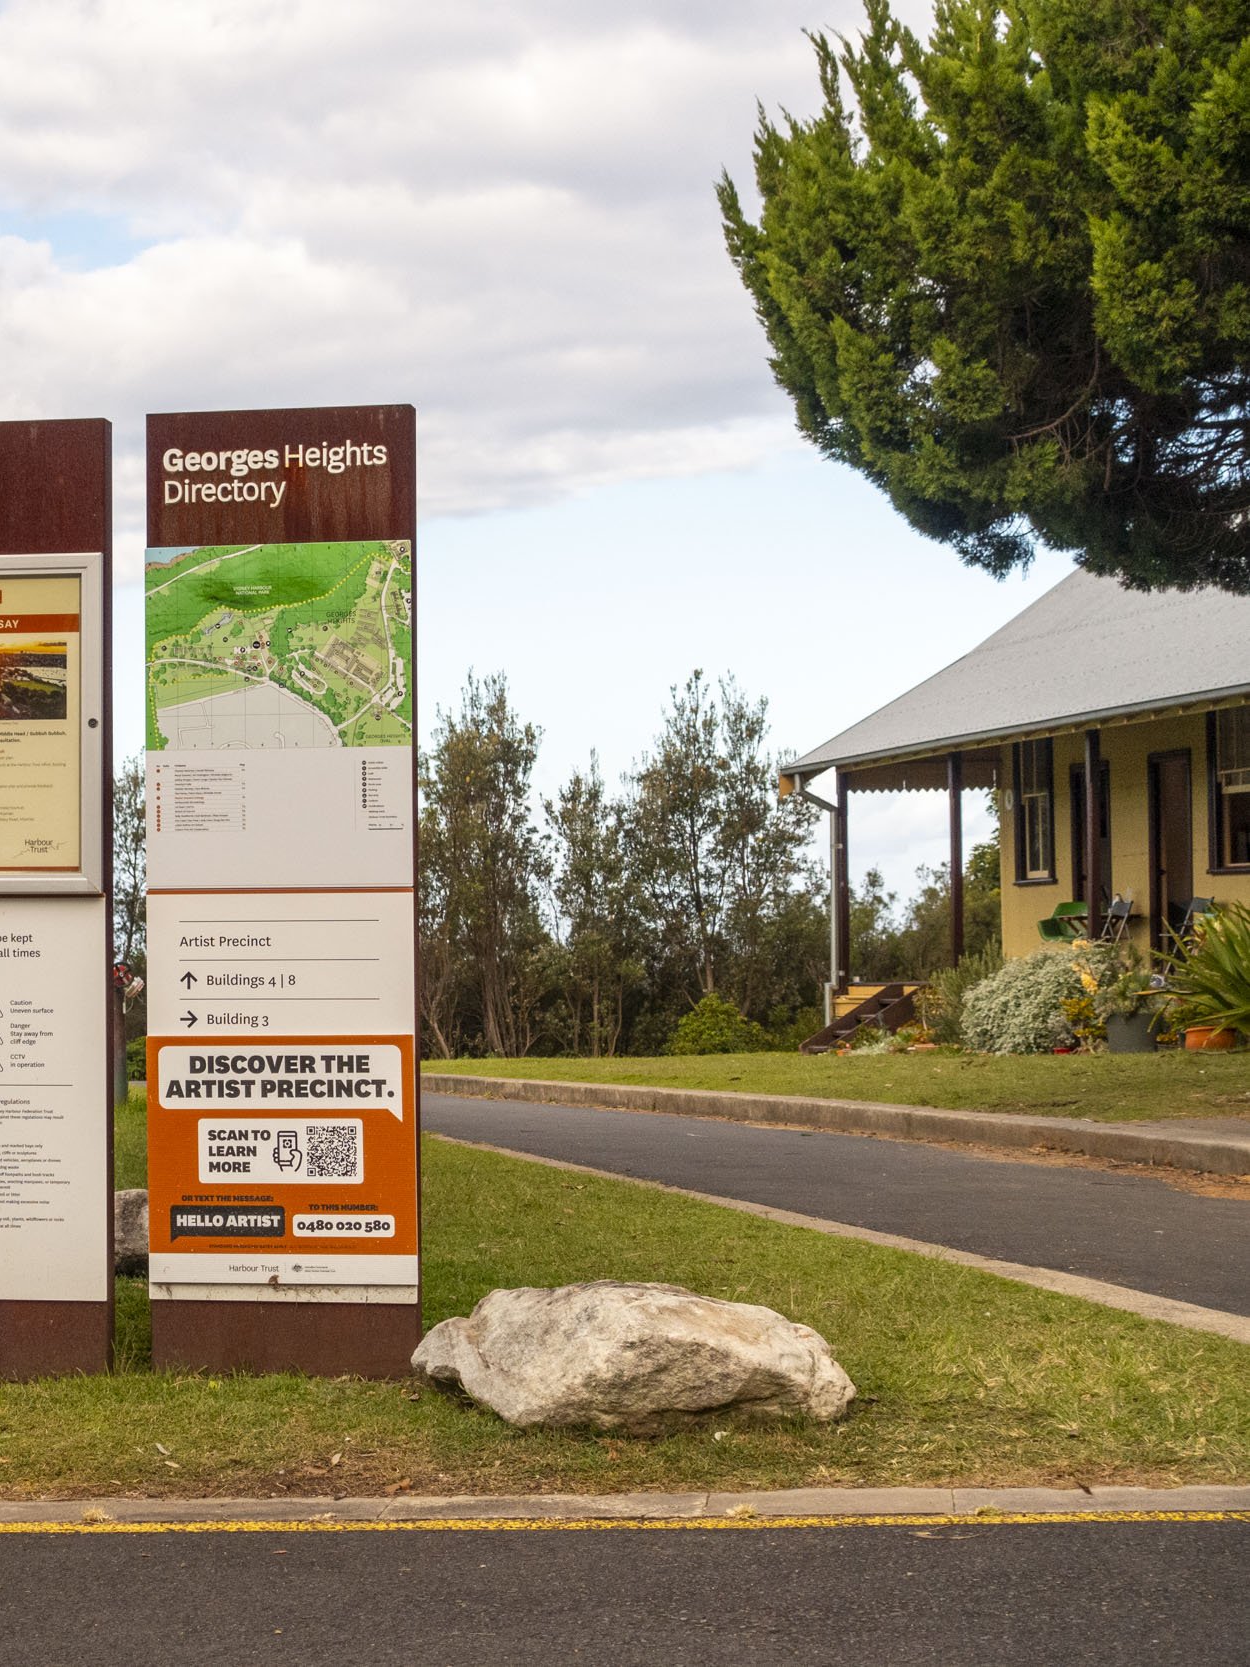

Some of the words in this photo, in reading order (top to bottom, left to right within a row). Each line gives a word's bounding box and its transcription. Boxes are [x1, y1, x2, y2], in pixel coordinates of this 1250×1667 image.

[163, 448, 279, 476] Georges
[285, 440, 387, 474] Heights
[164, 479, 286, 508] Directory
[326, 610, 358, 618] GEORGES
[326, 617, 357, 625] HEIGHTS
[24, 838, 53, 846] Harbour
[30, 846, 49, 854] Trust
[11, 933, 33, 945] kept
[180, 935, 215, 947] Artist
[219, 935, 271, 947] Precinct
[12, 948, 40, 958] times
[207, 974, 264, 989] Buildings
[268, 977, 276, 988] 4
[288, 974, 296, 985] 8
[207, 1013, 259, 1028] Building
[262, 1016, 269, 1027] 3
[189, 1055, 316, 1074] DISCOVER
[320, 1055, 370, 1073] THE
[166, 1079, 256, 1098] ARTIST
[261, 1079, 394, 1098] PRECINCT.
[208, 1130, 248, 1141] SCAN
[251, 1130, 271, 1141] TO
[209, 1146, 257, 1157] LEARN
[209, 1161, 250, 1173] MORE
[181, 1195, 194, 1203] OR
[193, 1195, 214, 1203] TEXT
[216, 1195, 232, 1203] THE
[320, 1204, 340, 1212] THIS
[340, 1204, 378, 1212] NUMBER:
[176, 1215, 224, 1227] HELLO
[226, 1215, 280, 1227] ARTIST
[297, 1220, 333, 1232] 0480
[336, 1222, 362, 1230] 020
[364, 1220, 390, 1233] 580
[229, 1264, 258, 1272] Harbour
[261, 1264, 279, 1272] Trust
